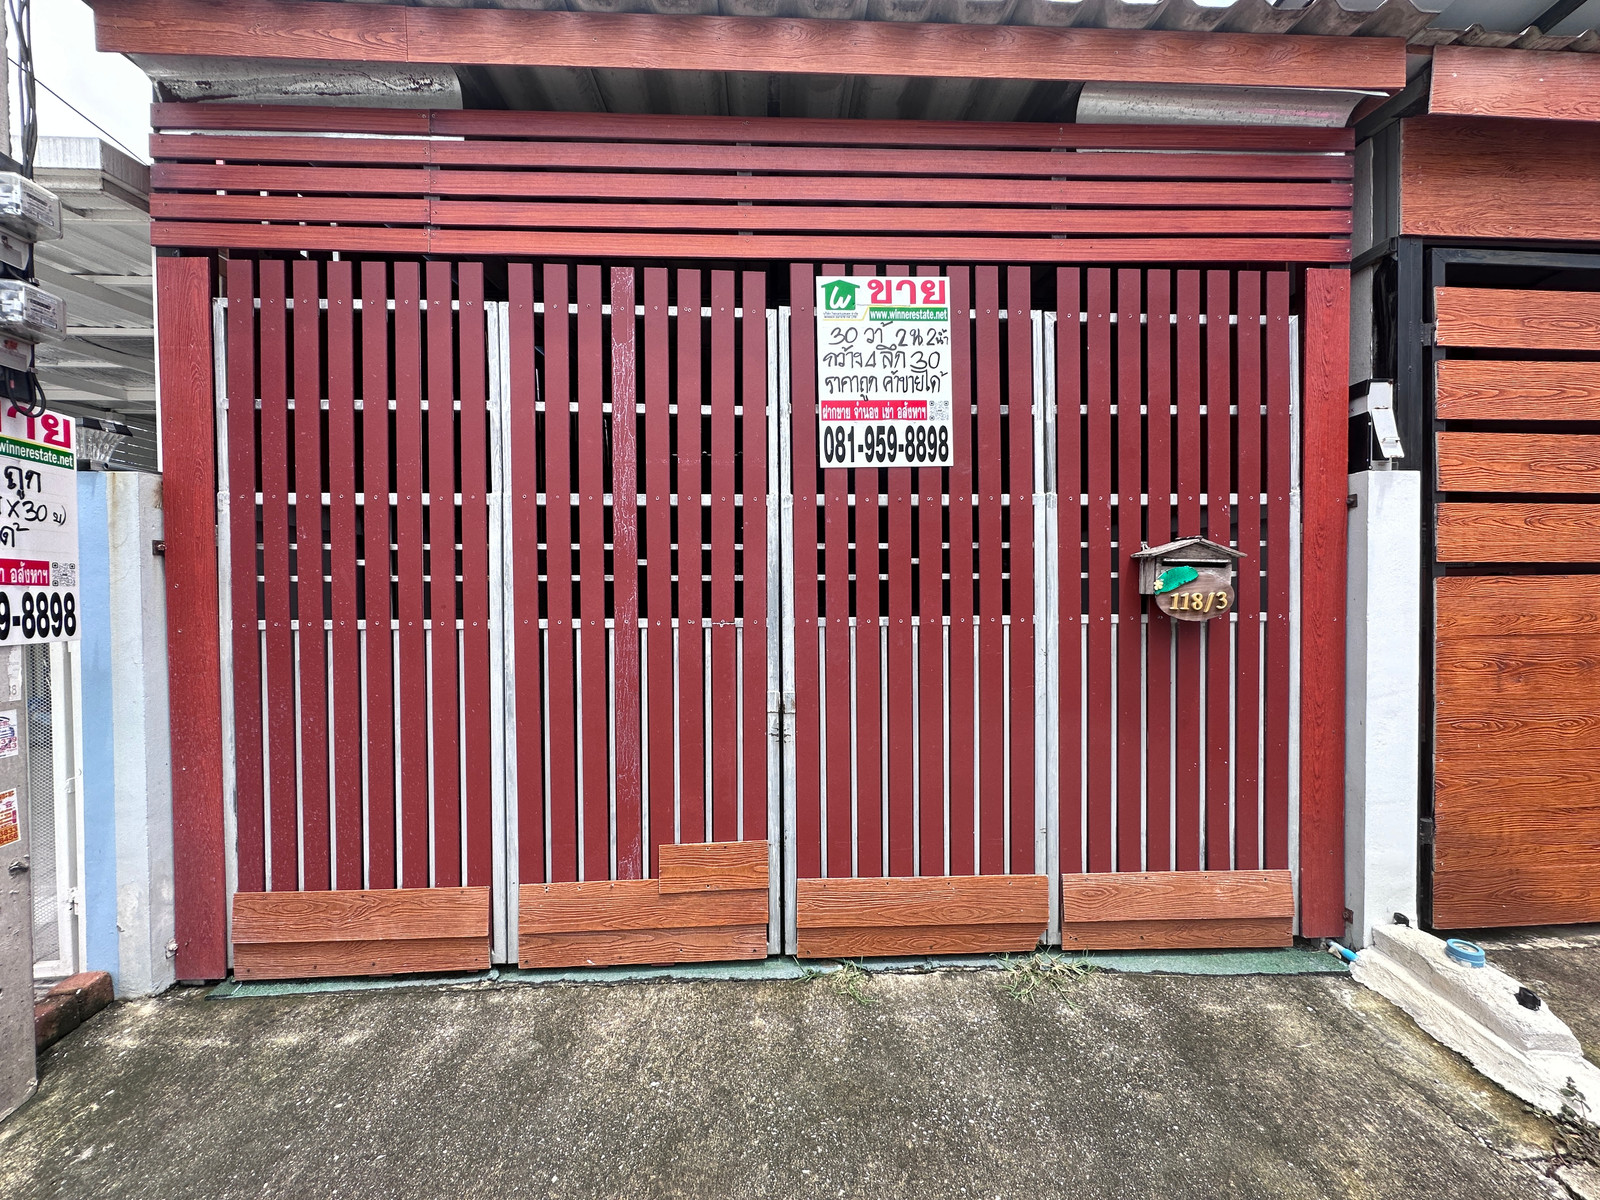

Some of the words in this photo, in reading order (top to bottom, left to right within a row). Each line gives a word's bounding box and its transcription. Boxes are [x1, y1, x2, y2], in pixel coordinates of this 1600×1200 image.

[867, 279, 946, 305] ขาย
[869, 308, 948, 321] www.winnerestate.net
[828, 327, 858, 345] 30
[910, 351, 940, 370] 30
[825, 375, 878, 402] ราคาถูก
[822, 404, 851, 420] ฝากขาย
[854, 401, 879, 420] จำนอง
[882, 401, 894, 419] เช่า
[0, 400, 71, 449] าย
[823, 425, 949, 463] 081-959-8898
[1169, 591, 1228, 613] 118/3
